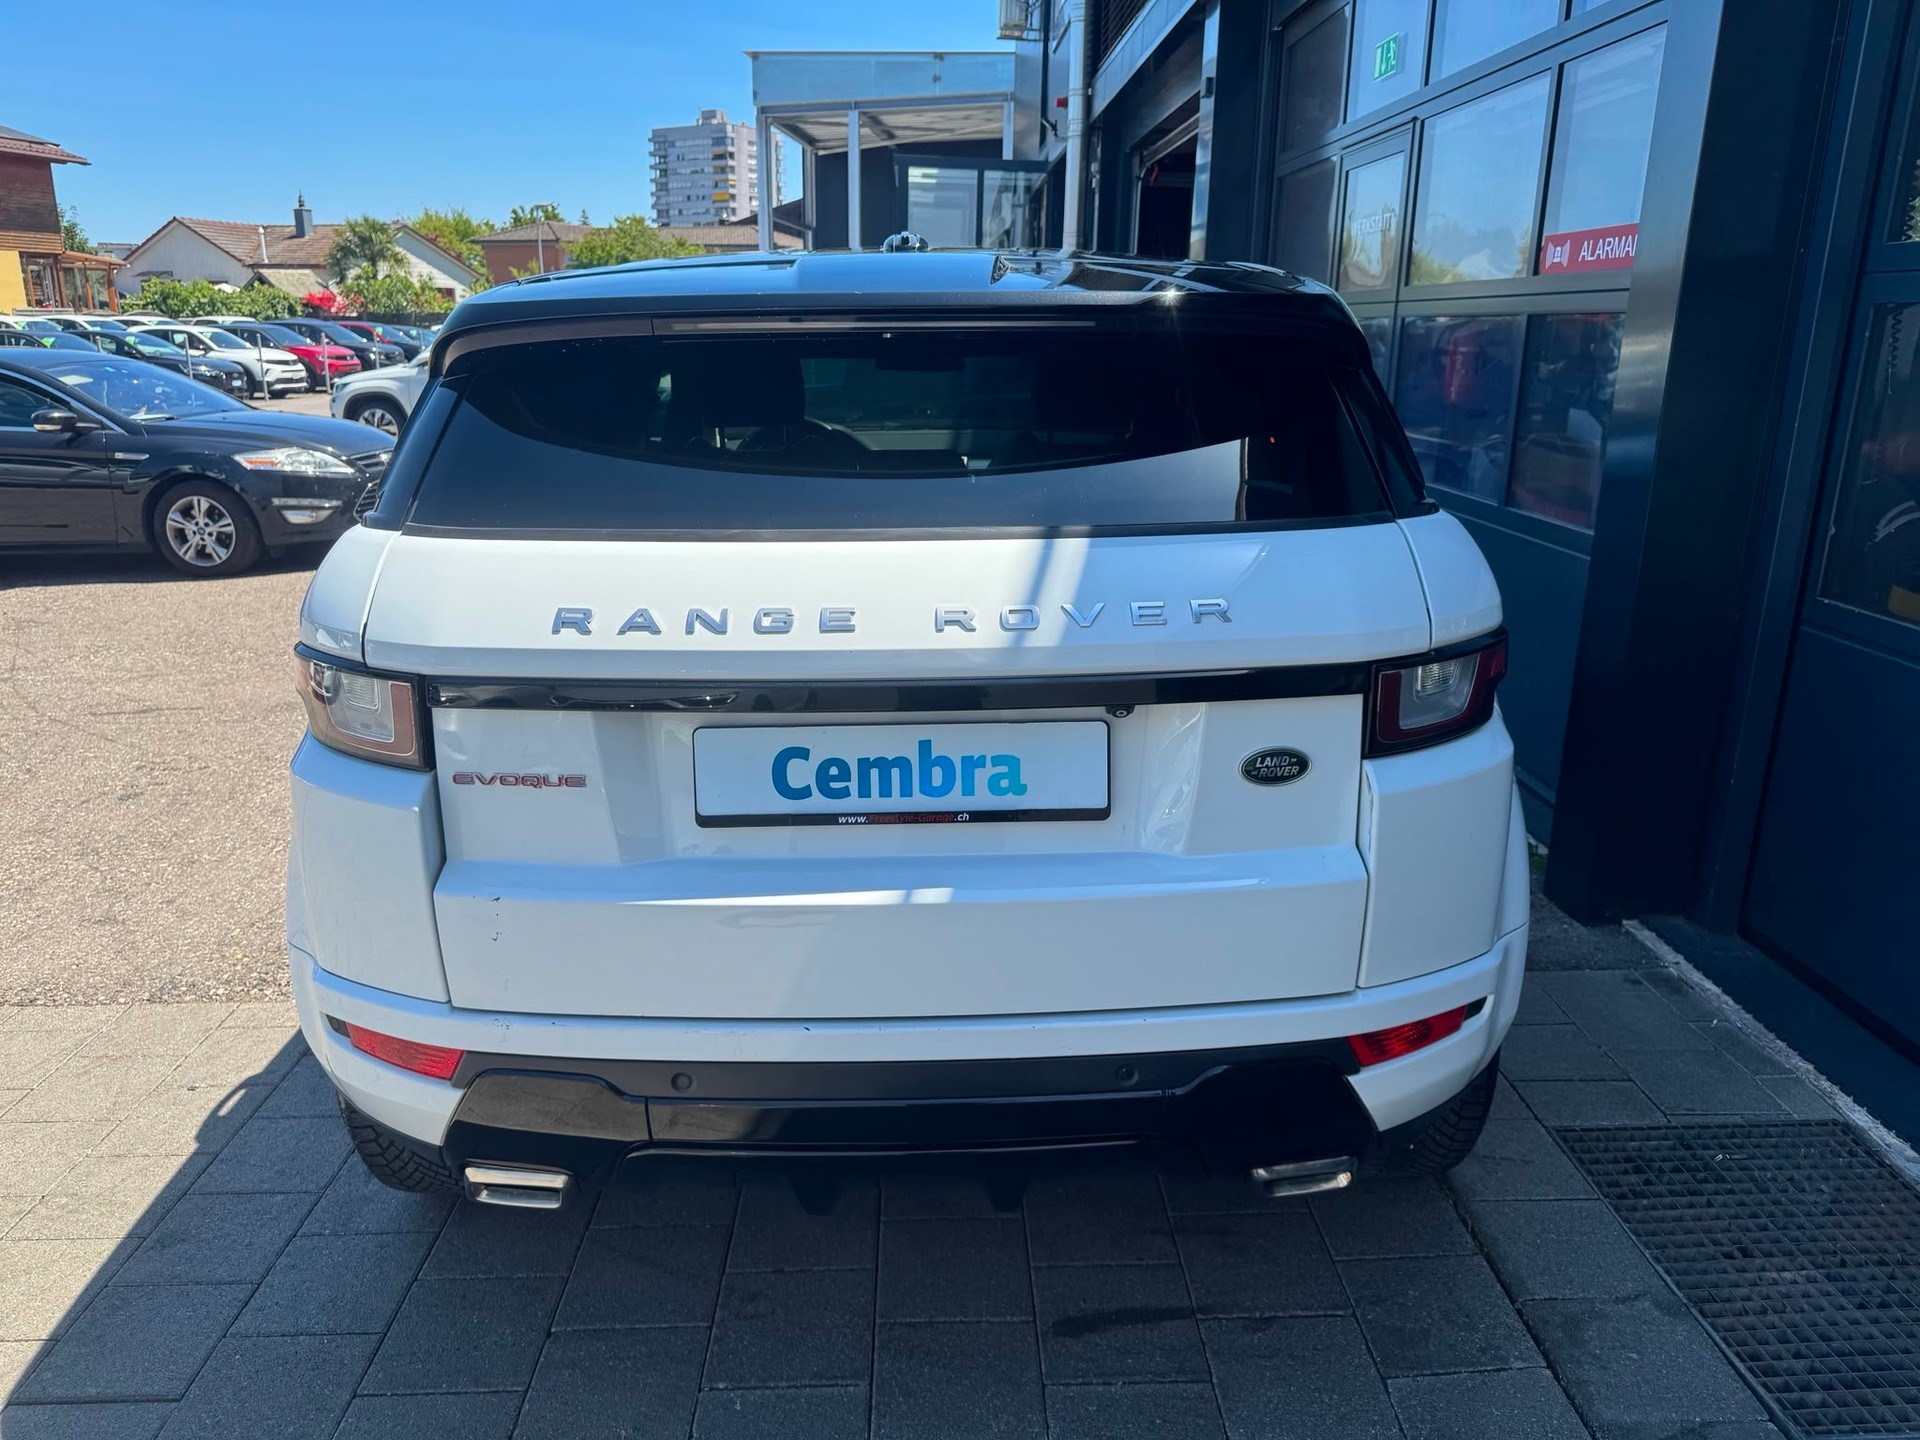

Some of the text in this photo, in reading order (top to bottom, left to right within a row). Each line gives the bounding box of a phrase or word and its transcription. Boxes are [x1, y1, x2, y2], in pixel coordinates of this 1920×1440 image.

[551, 599, 1232, 635] RANGE ROVER
[1255, 756, 1290, 768] LAND
[771, 739, 1028, 801] Cembra
[1259, 766, 1300, 778] ROVER
[452, 771, 587, 789] EVOQUE
[838, 812, 970, 824] www.Freestyle-Garage.ch
